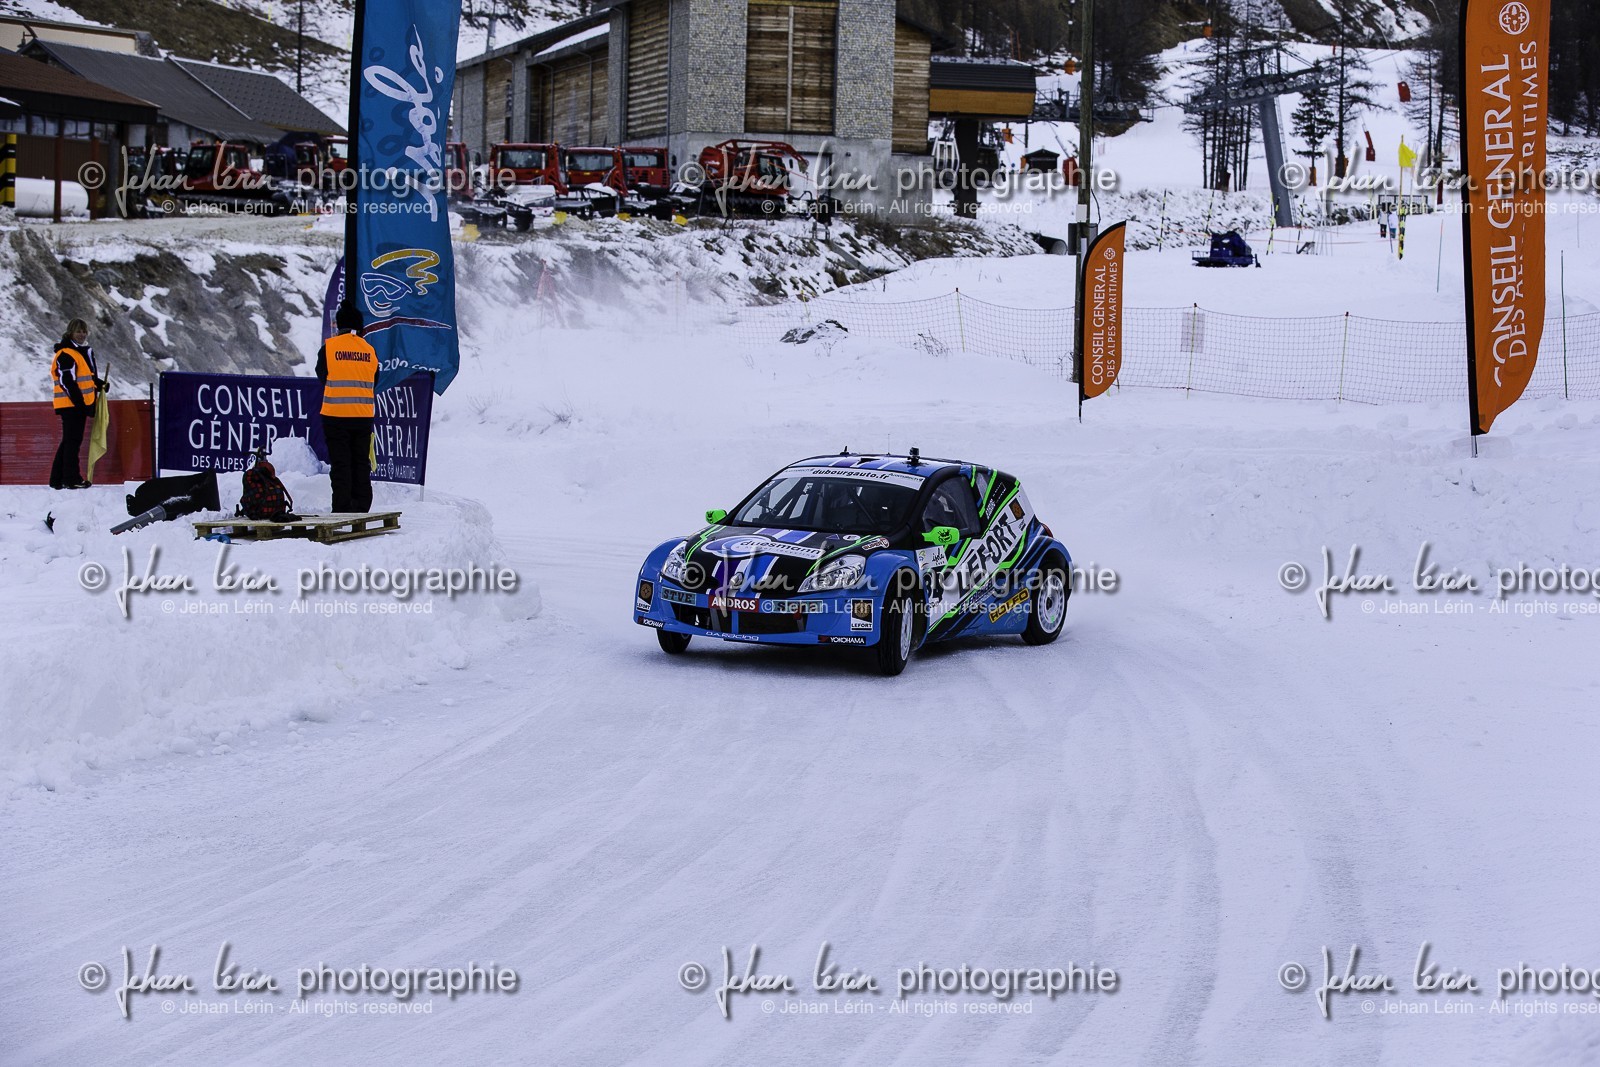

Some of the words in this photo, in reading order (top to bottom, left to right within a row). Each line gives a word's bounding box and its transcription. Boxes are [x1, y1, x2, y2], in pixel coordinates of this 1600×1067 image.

[1480, 54, 1516, 229] GENERAL
[1092, 265, 1106, 328] GENERAL
[1491, 235, 1517, 388] ONSEIL
[1509, 308, 1528, 358] DES
[335, 351, 371, 362] COMMISSAIRE
[1091, 329, 1105, 385] CONSEIL
[1107, 359, 1115, 378] DES
[197, 384, 308, 419] CONSEIL
[192, 455, 210, 468] DES
[214, 456, 244, 471] ALPES
[812, 469, 889, 480] dubourgauto.fr
[740, 541, 821, 555] duesmann
[712, 596, 756, 610] ANDROS
[830, 636, 864, 644] YOKOHAMA
